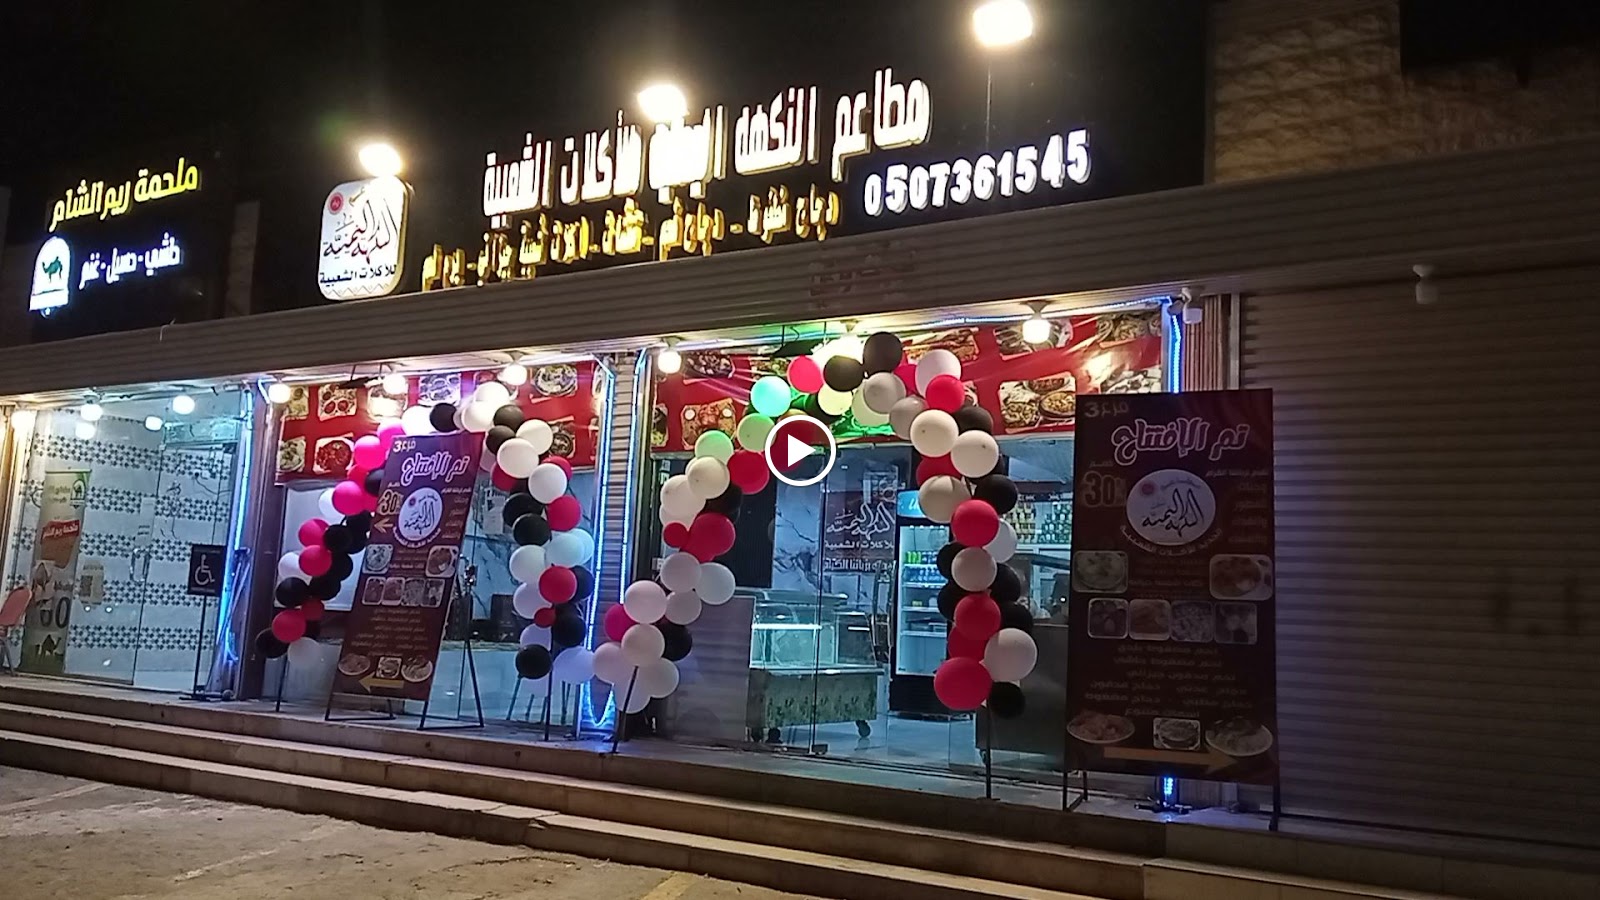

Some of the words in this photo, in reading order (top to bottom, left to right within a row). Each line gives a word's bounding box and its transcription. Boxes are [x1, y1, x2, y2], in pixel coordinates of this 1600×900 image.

[832, 68, 931, 182] مطاعم
[134, 157, 200, 203] ملحمة
[864, 130, 1091, 217] 0507361545
[49, 179, 104, 232] الشام
[100, 181, 131, 220] ريم
[1083, 401, 1100, 418] 3
[392, 440, 402, 453] 3
[1208, 423, 1251, 462] تم
[445, 455, 470, 483] تم
